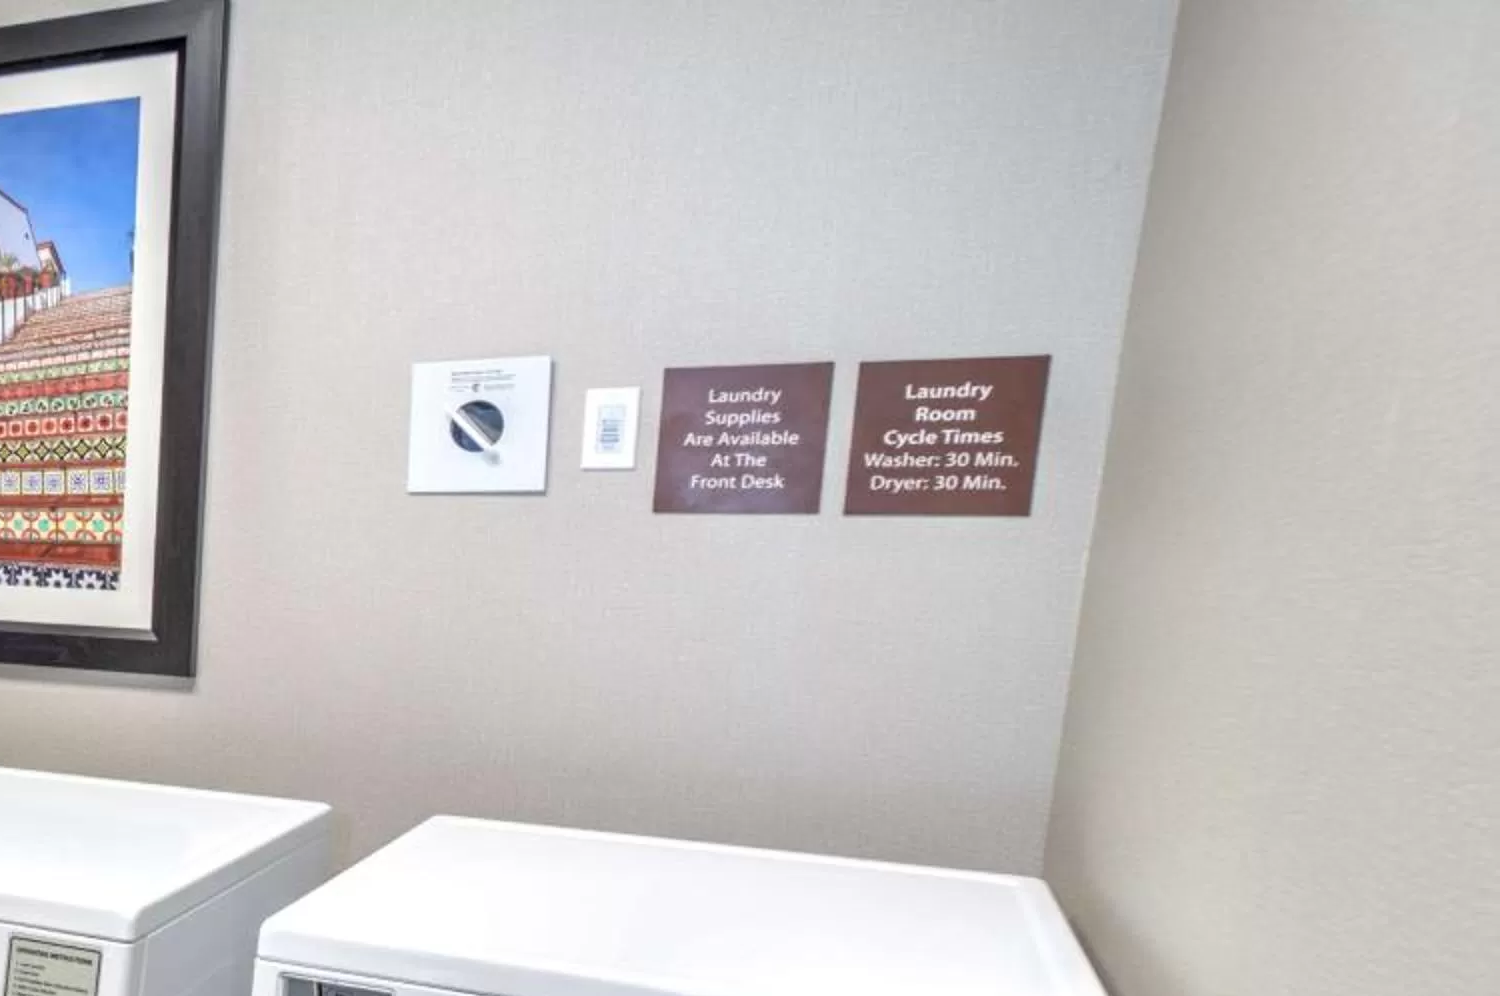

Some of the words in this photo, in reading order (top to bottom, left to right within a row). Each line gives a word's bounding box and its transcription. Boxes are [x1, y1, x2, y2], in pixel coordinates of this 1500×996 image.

[708, 387, 782, 405] Laundry
[905, 381, 994, 401] Laundry
[705, 409, 781, 427] Supplies
[915, 406, 977, 422] Room
[683, 432, 713, 447] Are
[717, 430, 800, 446] Available
[883, 429, 938, 449] Cycle
[941, 428, 1004, 444] Times
[710, 453, 729, 468] At
[735, 453, 768, 467] The
[864, 452, 940, 468] Washer:
[945, 452, 970, 467] 30
[974, 451, 1020, 467] Min.
[690, 474, 737, 489] Front
[741, 473, 786, 489] Desk
[870, 475, 930, 493] Dryer:
[934, 475, 958, 490] 30
[962, 475, 1007, 490] Min.
